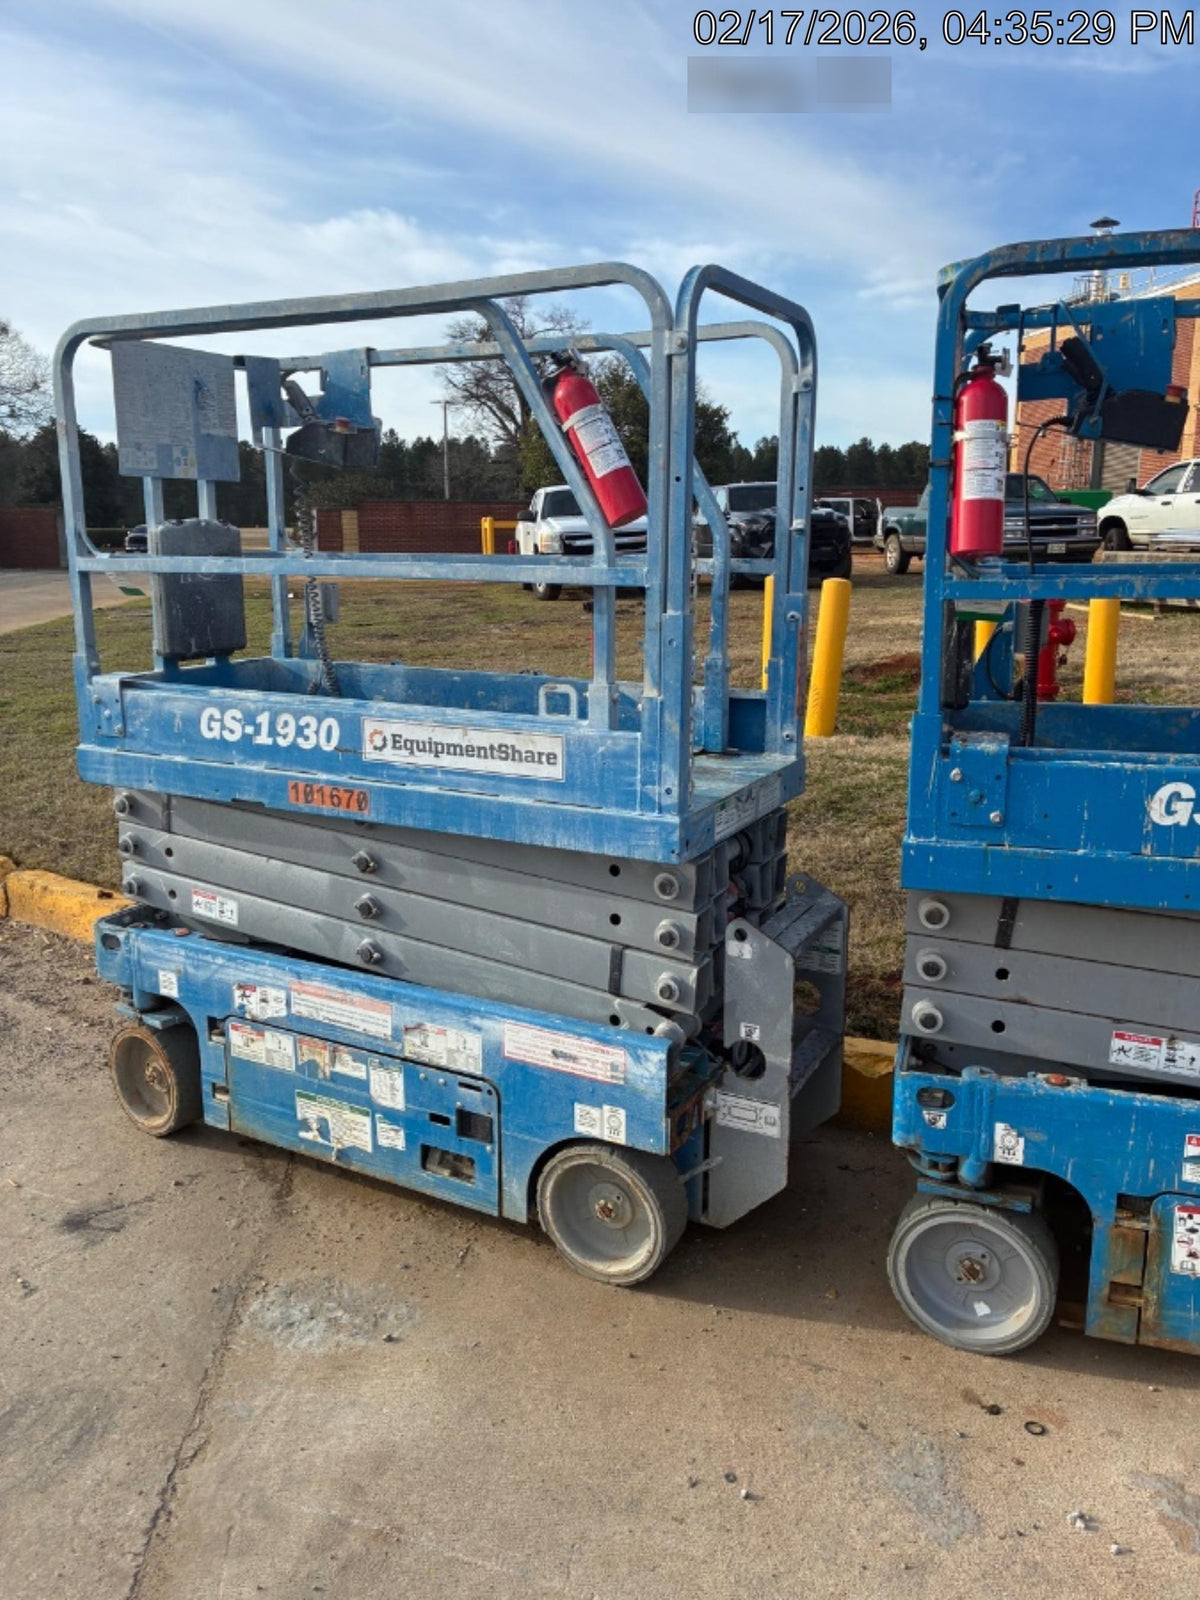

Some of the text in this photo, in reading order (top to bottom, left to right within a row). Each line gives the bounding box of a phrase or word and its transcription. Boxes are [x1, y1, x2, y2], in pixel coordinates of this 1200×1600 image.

[200, 706, 341, 752] GS-1930
[390, 732, 559, 766] EquipmentShare
[290, 781, 369, 812] 101670
[1149, 781, 1200, 827] G
